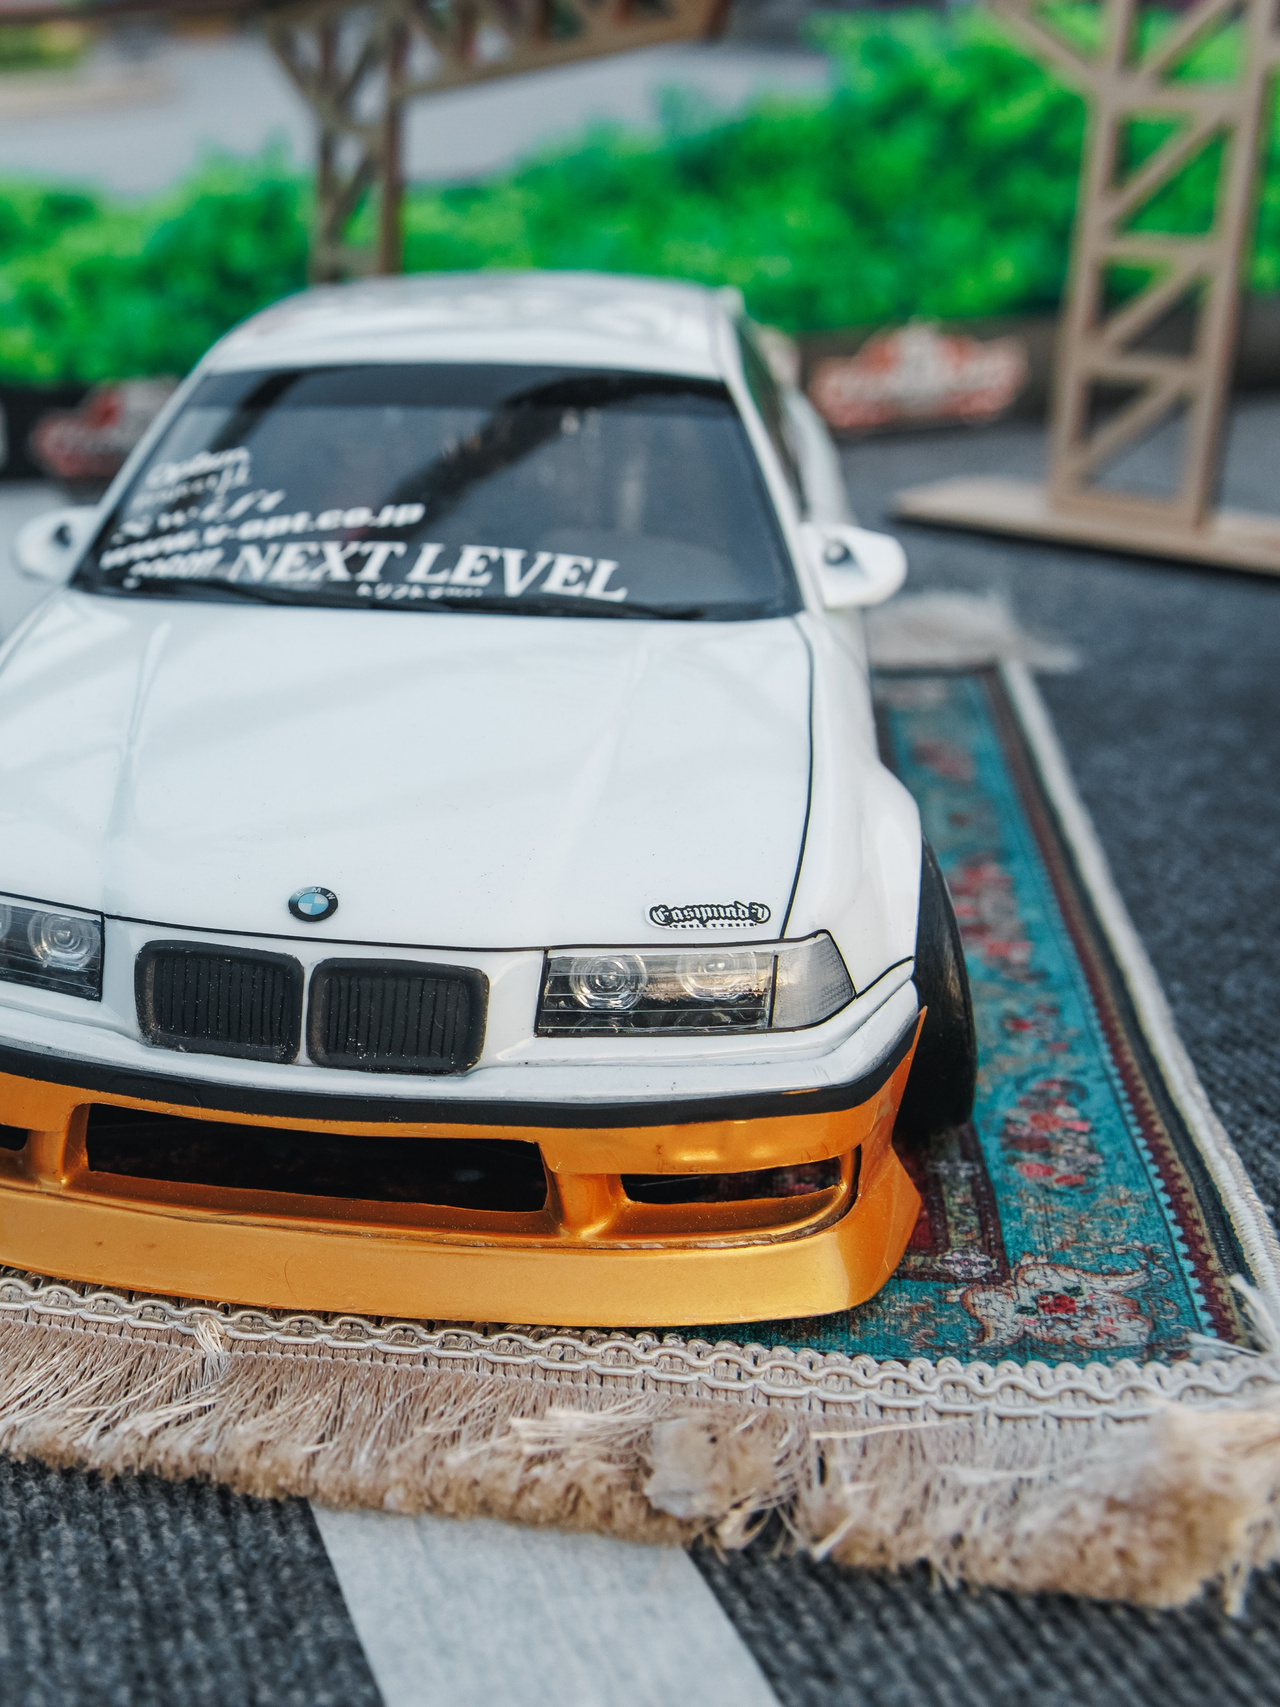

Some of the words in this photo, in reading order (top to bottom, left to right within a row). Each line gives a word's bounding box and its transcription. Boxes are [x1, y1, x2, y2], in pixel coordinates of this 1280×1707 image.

[228, 539, 408, 584] NEXT
[405, 541, 629, 603] LEVEL
[295, 886, 336, 901] BMW
